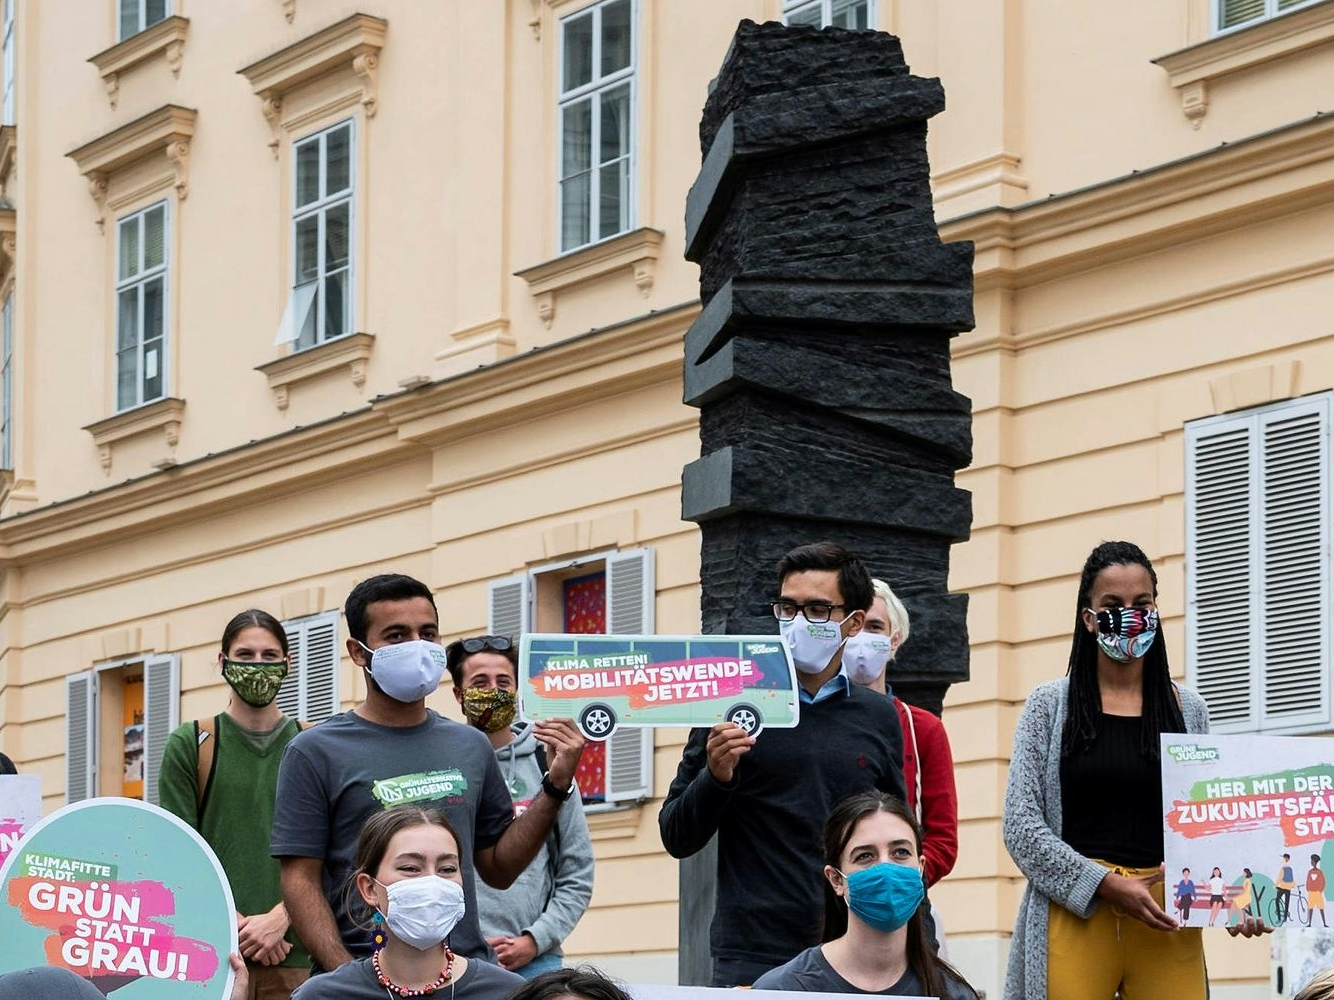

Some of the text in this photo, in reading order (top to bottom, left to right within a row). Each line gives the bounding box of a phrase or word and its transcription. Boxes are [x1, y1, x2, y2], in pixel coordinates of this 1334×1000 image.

[546, 653, 648, 671] KLIMA RETTEN!
[543, 660, 753, 692] MOBILITÄTSWENDE
[643, 681, 718, 702] JETZT!
[1176, 750, 1216, 761] JUGEND
[405, 782, 453, 798] JUGEND
[1206, 775, 1333, 799] HER MIT DER
[25, 854, 111, 877] KLIMAFITTE
[28, 866, 76, 883] STADT:
[28, 881, 141, 924] GRÜN
[75, 918, 155, 946] STATT
[61, 937, 189, 981] GRAU!
